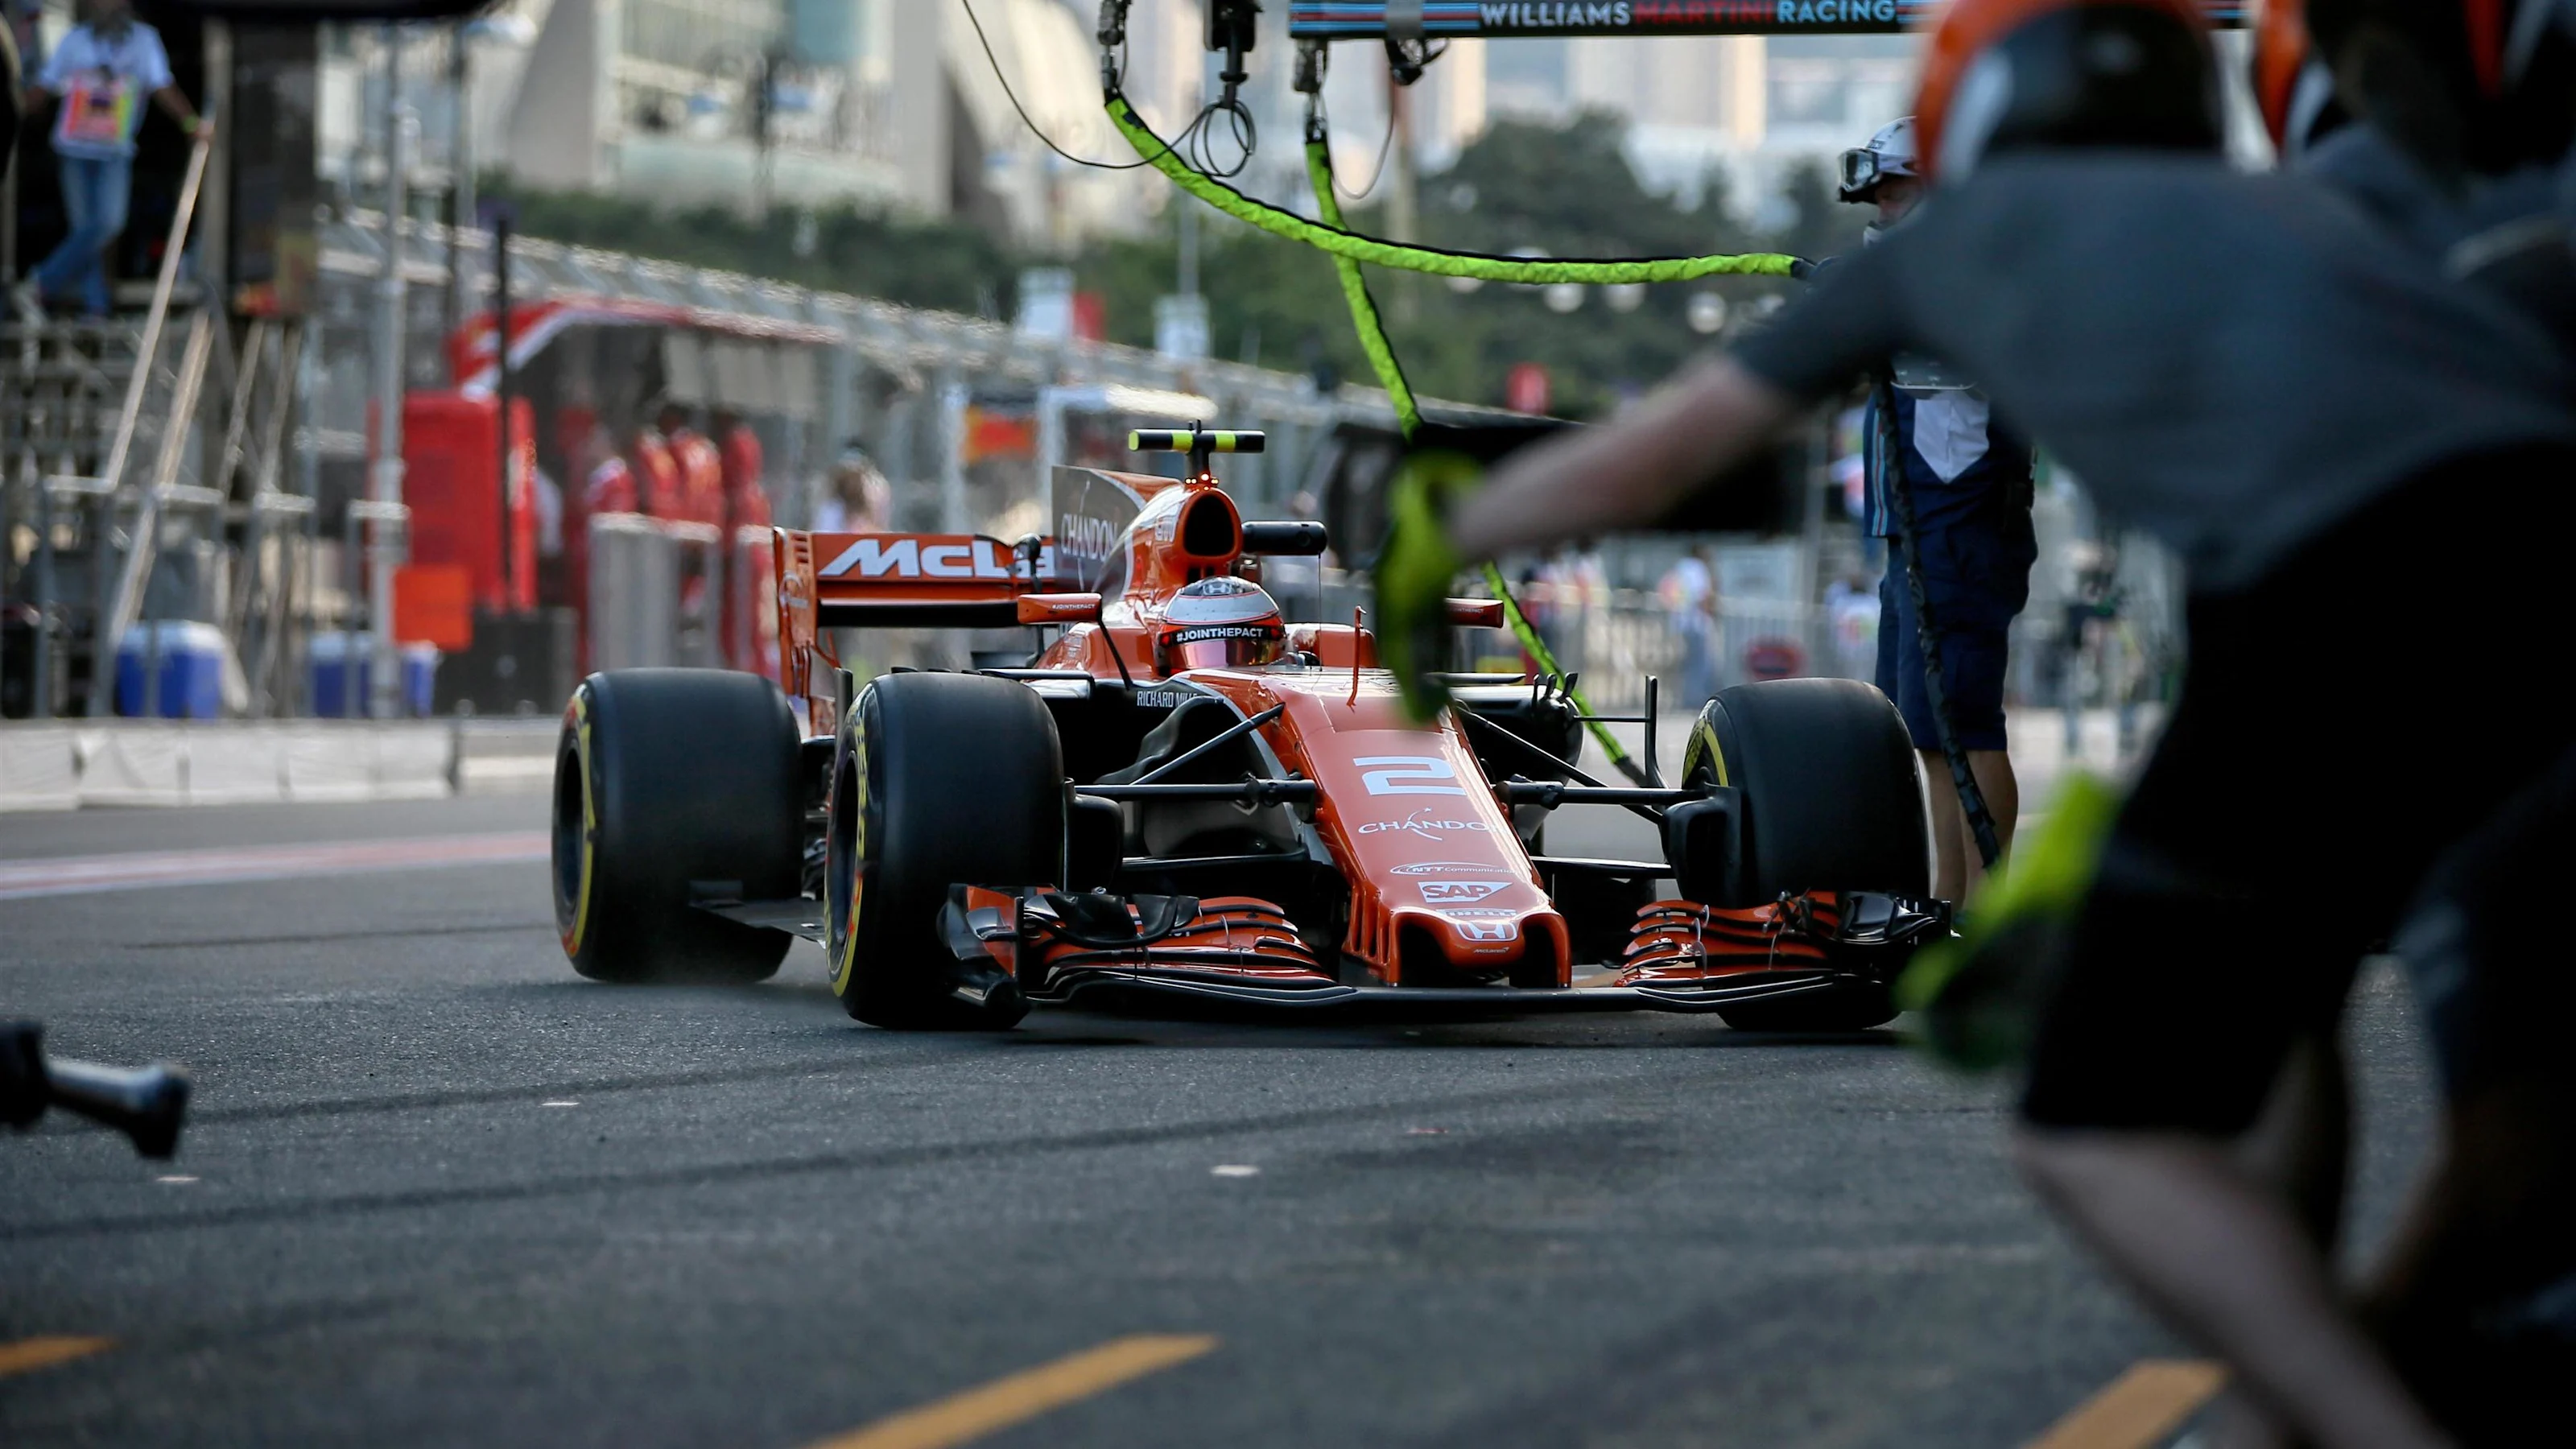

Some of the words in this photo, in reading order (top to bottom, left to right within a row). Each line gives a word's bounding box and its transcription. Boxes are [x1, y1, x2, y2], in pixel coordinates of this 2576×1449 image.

[1480, 2, 1631, 27] WILLIAMS
[1633, 1, 1773, 25] MARTINI
[1777, 1, 1897, 23] RACING
[1176, 628, 1263, 642] #JOINTHEPACT
[1137, 691, 1174, 708] RICHARD
[1352, 756, 1467, 795] 2
[1422, 885, 1492, 898] SAP
